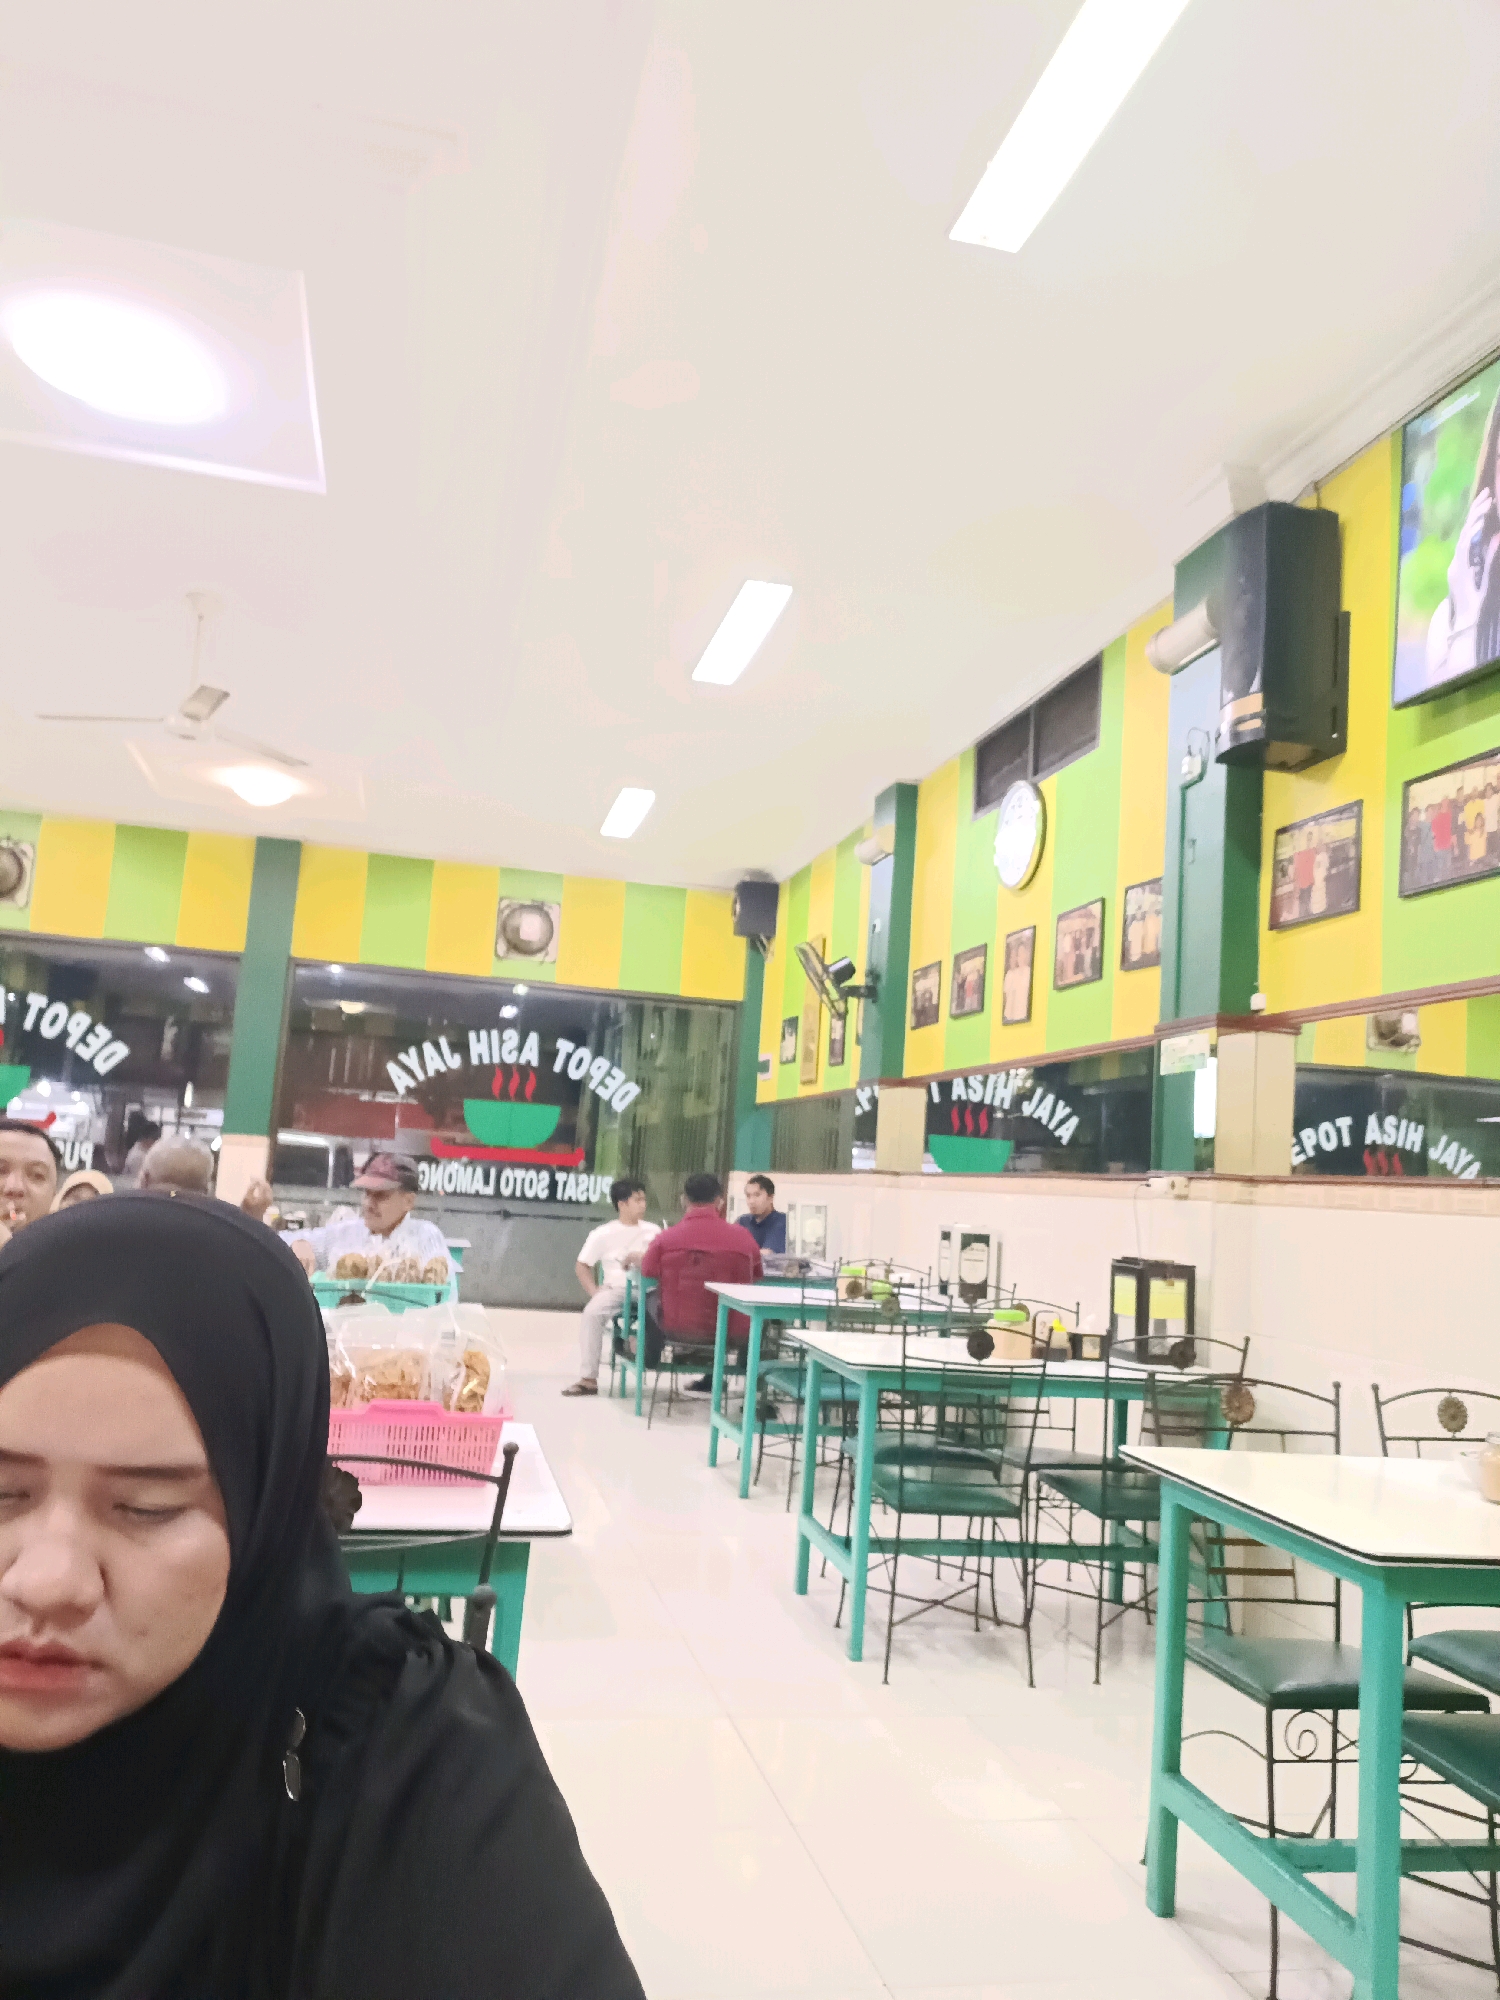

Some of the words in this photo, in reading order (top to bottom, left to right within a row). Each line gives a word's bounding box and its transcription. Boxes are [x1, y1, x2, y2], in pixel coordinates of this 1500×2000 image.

[951, 1069, 1017, 1110] ASIH
[1021, 1086, 1081, 1146] JAYA
[1364, 1112, 1425, 1154] ASIH
[1428, 1134, 1482, 1180] JAYA
